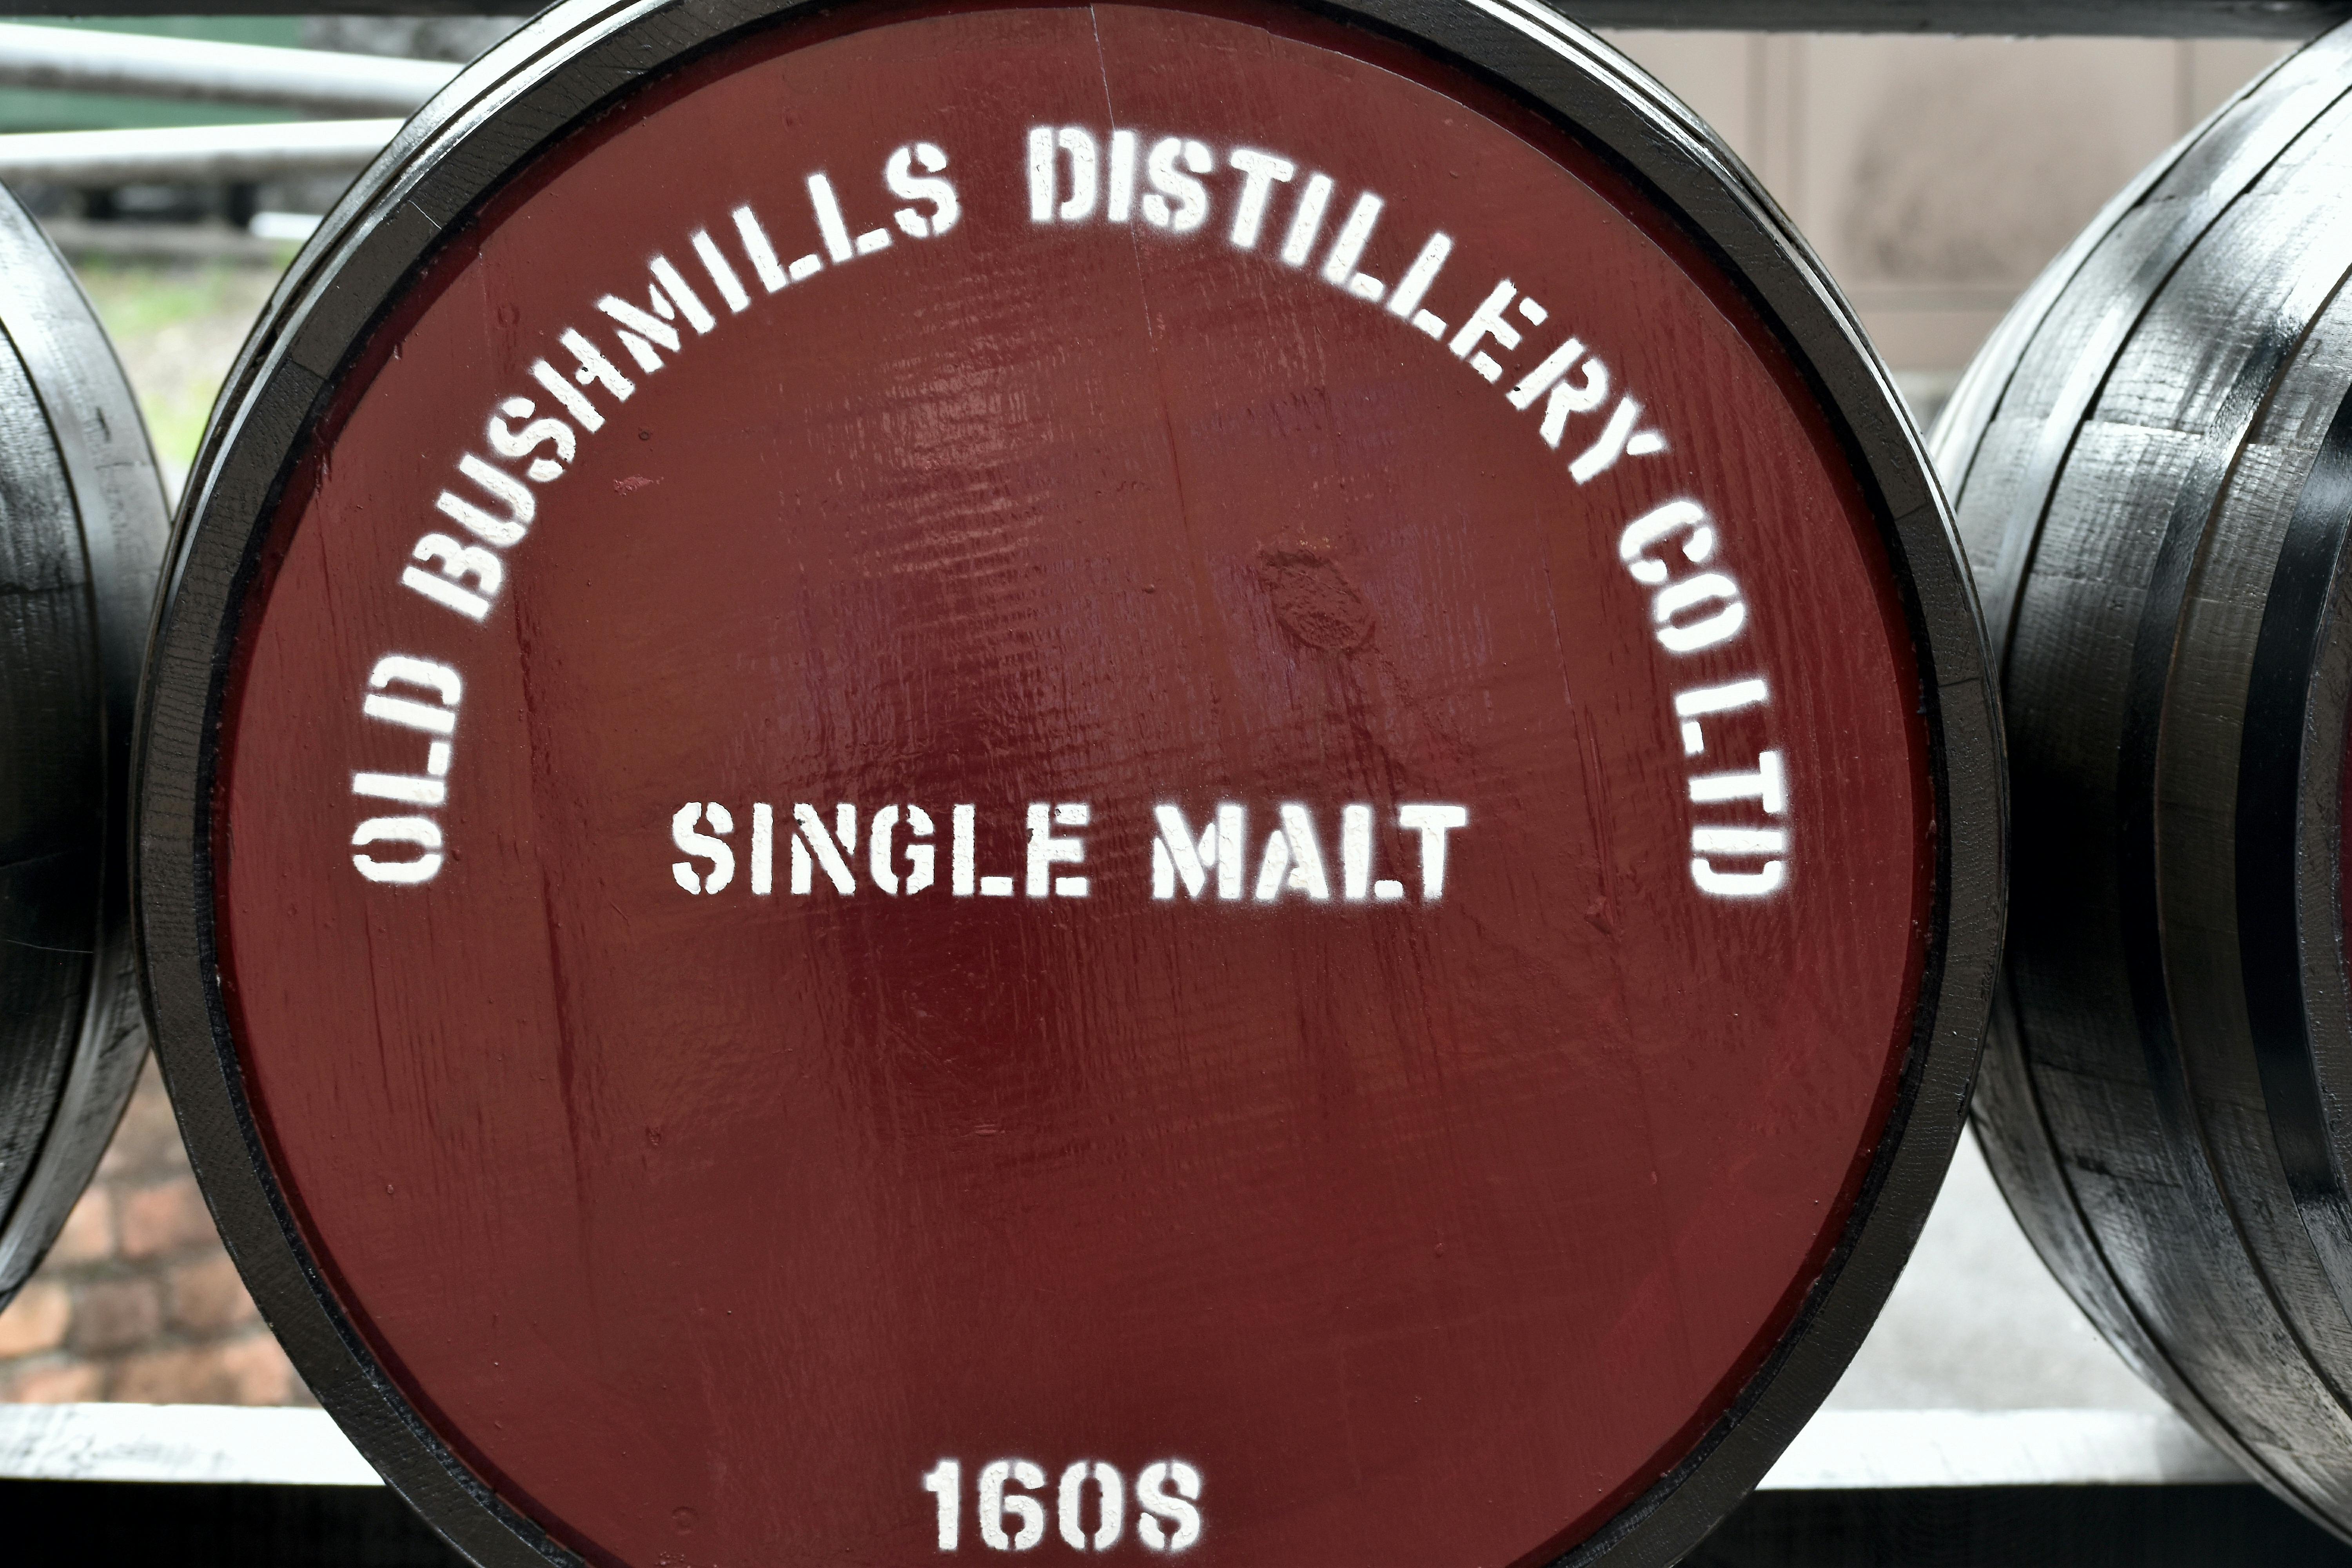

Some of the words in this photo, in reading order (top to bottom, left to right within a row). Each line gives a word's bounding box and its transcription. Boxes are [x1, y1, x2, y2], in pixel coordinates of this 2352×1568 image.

[401, 141, 961, 622] BUSHMILLS
[1025, 125, 1667, 485] DISTILLERY
[352, 654, 463, 884] OLD
[671, 801, 1091, 898] SINGLE
[1151, 802, 1468, 902] MALT
[1674, 678, 1788, 897] LTD
[924, 1459, 1202, 1552] 160S
